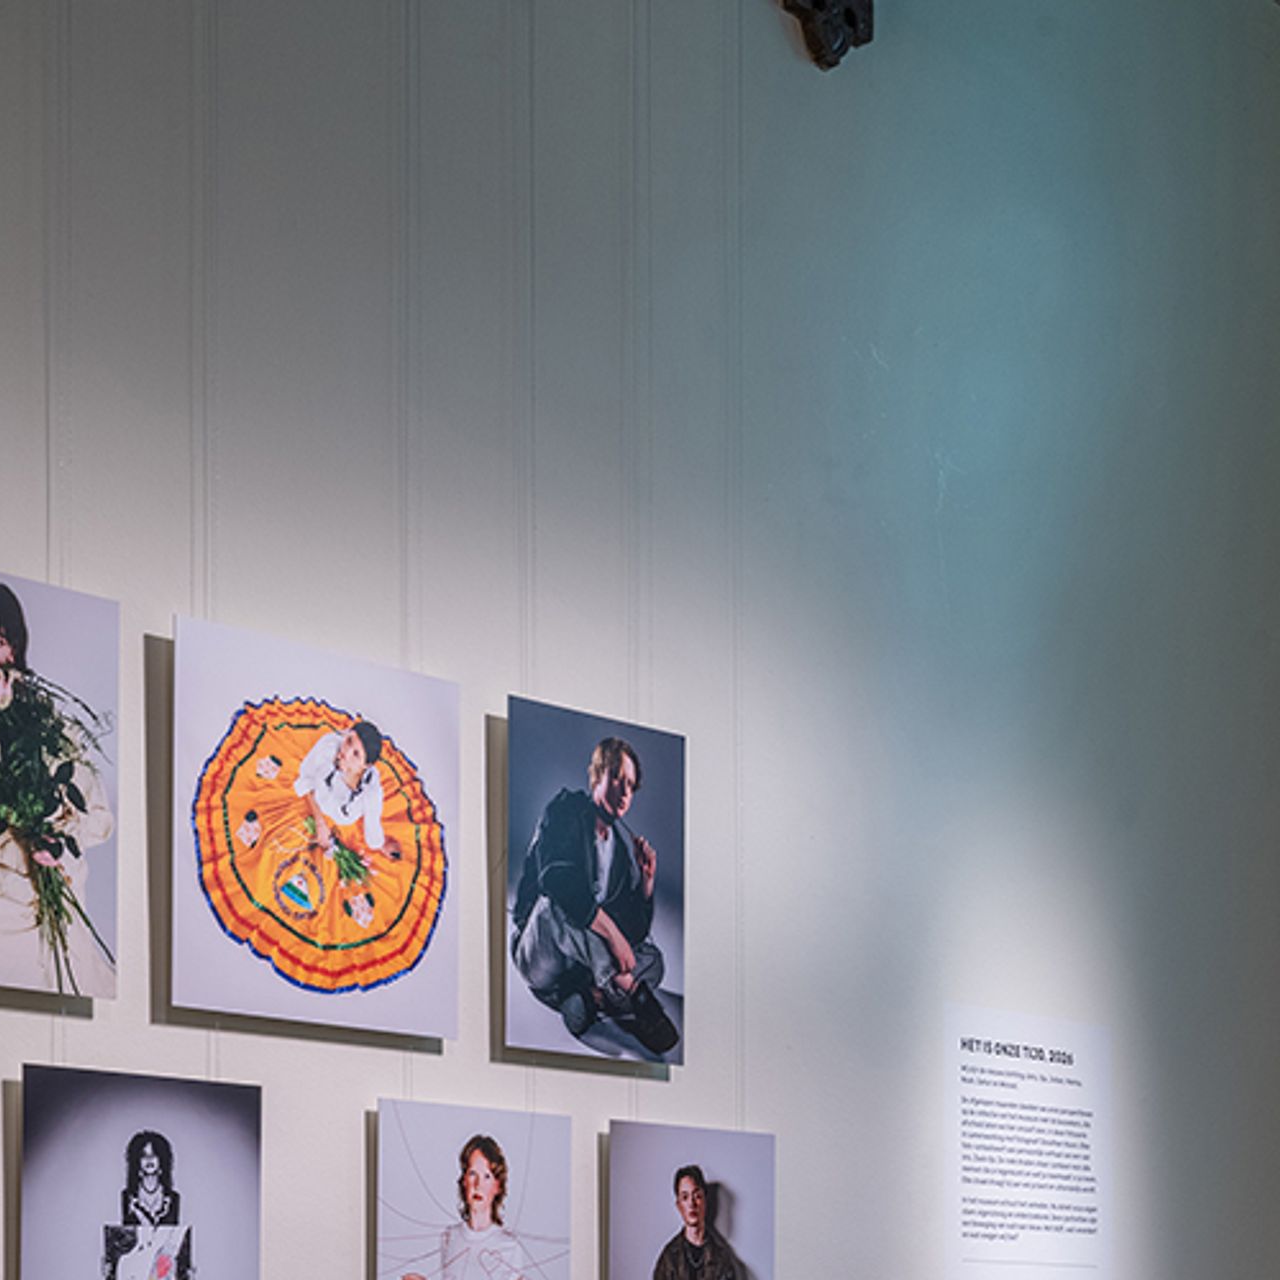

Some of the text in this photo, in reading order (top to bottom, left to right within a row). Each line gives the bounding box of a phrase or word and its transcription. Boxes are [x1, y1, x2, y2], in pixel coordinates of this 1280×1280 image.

[960, 1037, 981, 1053] HET
[983, 1040, 992, 1055] IS
[994, 1041, 1020, 1058] ONZE
